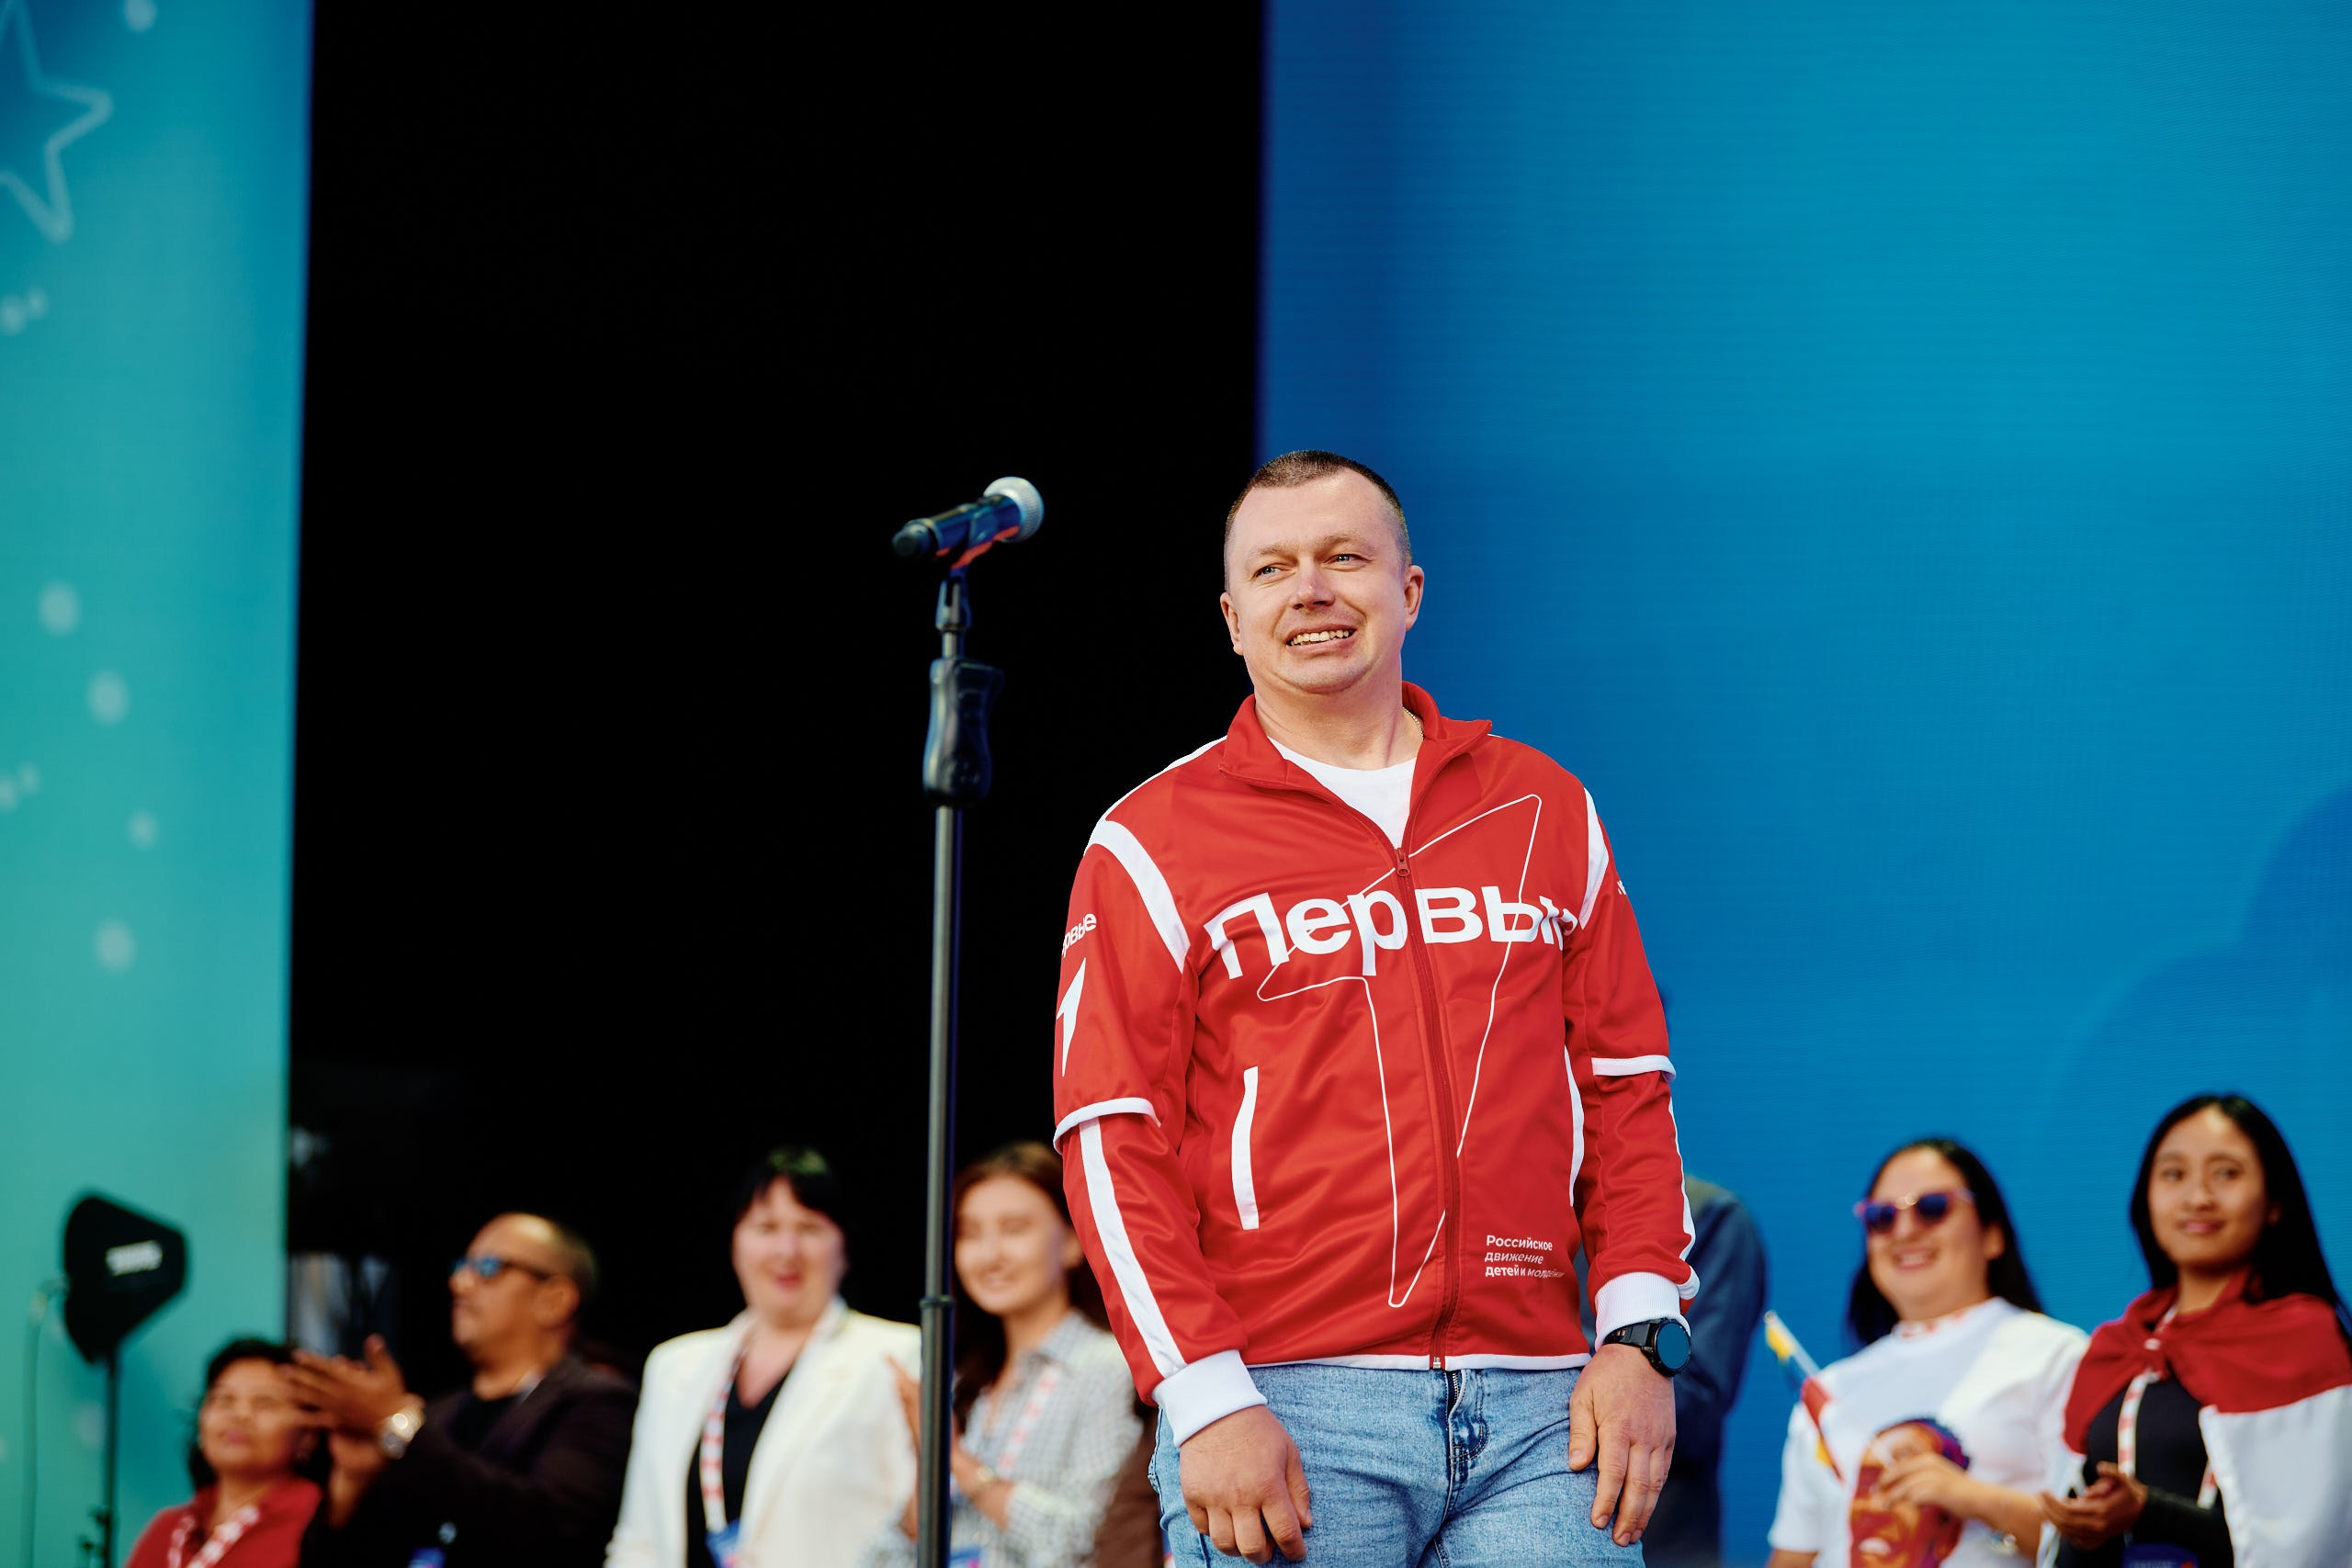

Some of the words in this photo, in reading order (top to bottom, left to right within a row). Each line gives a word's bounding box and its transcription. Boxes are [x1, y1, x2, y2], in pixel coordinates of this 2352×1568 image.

[1486, 1235, 1554, 1251] Российское
[1484, 1252, 1544, 1265] движение
[1485, 1265, 1520, 1278] детей
[1520, 1267, 1526, 1277] и
